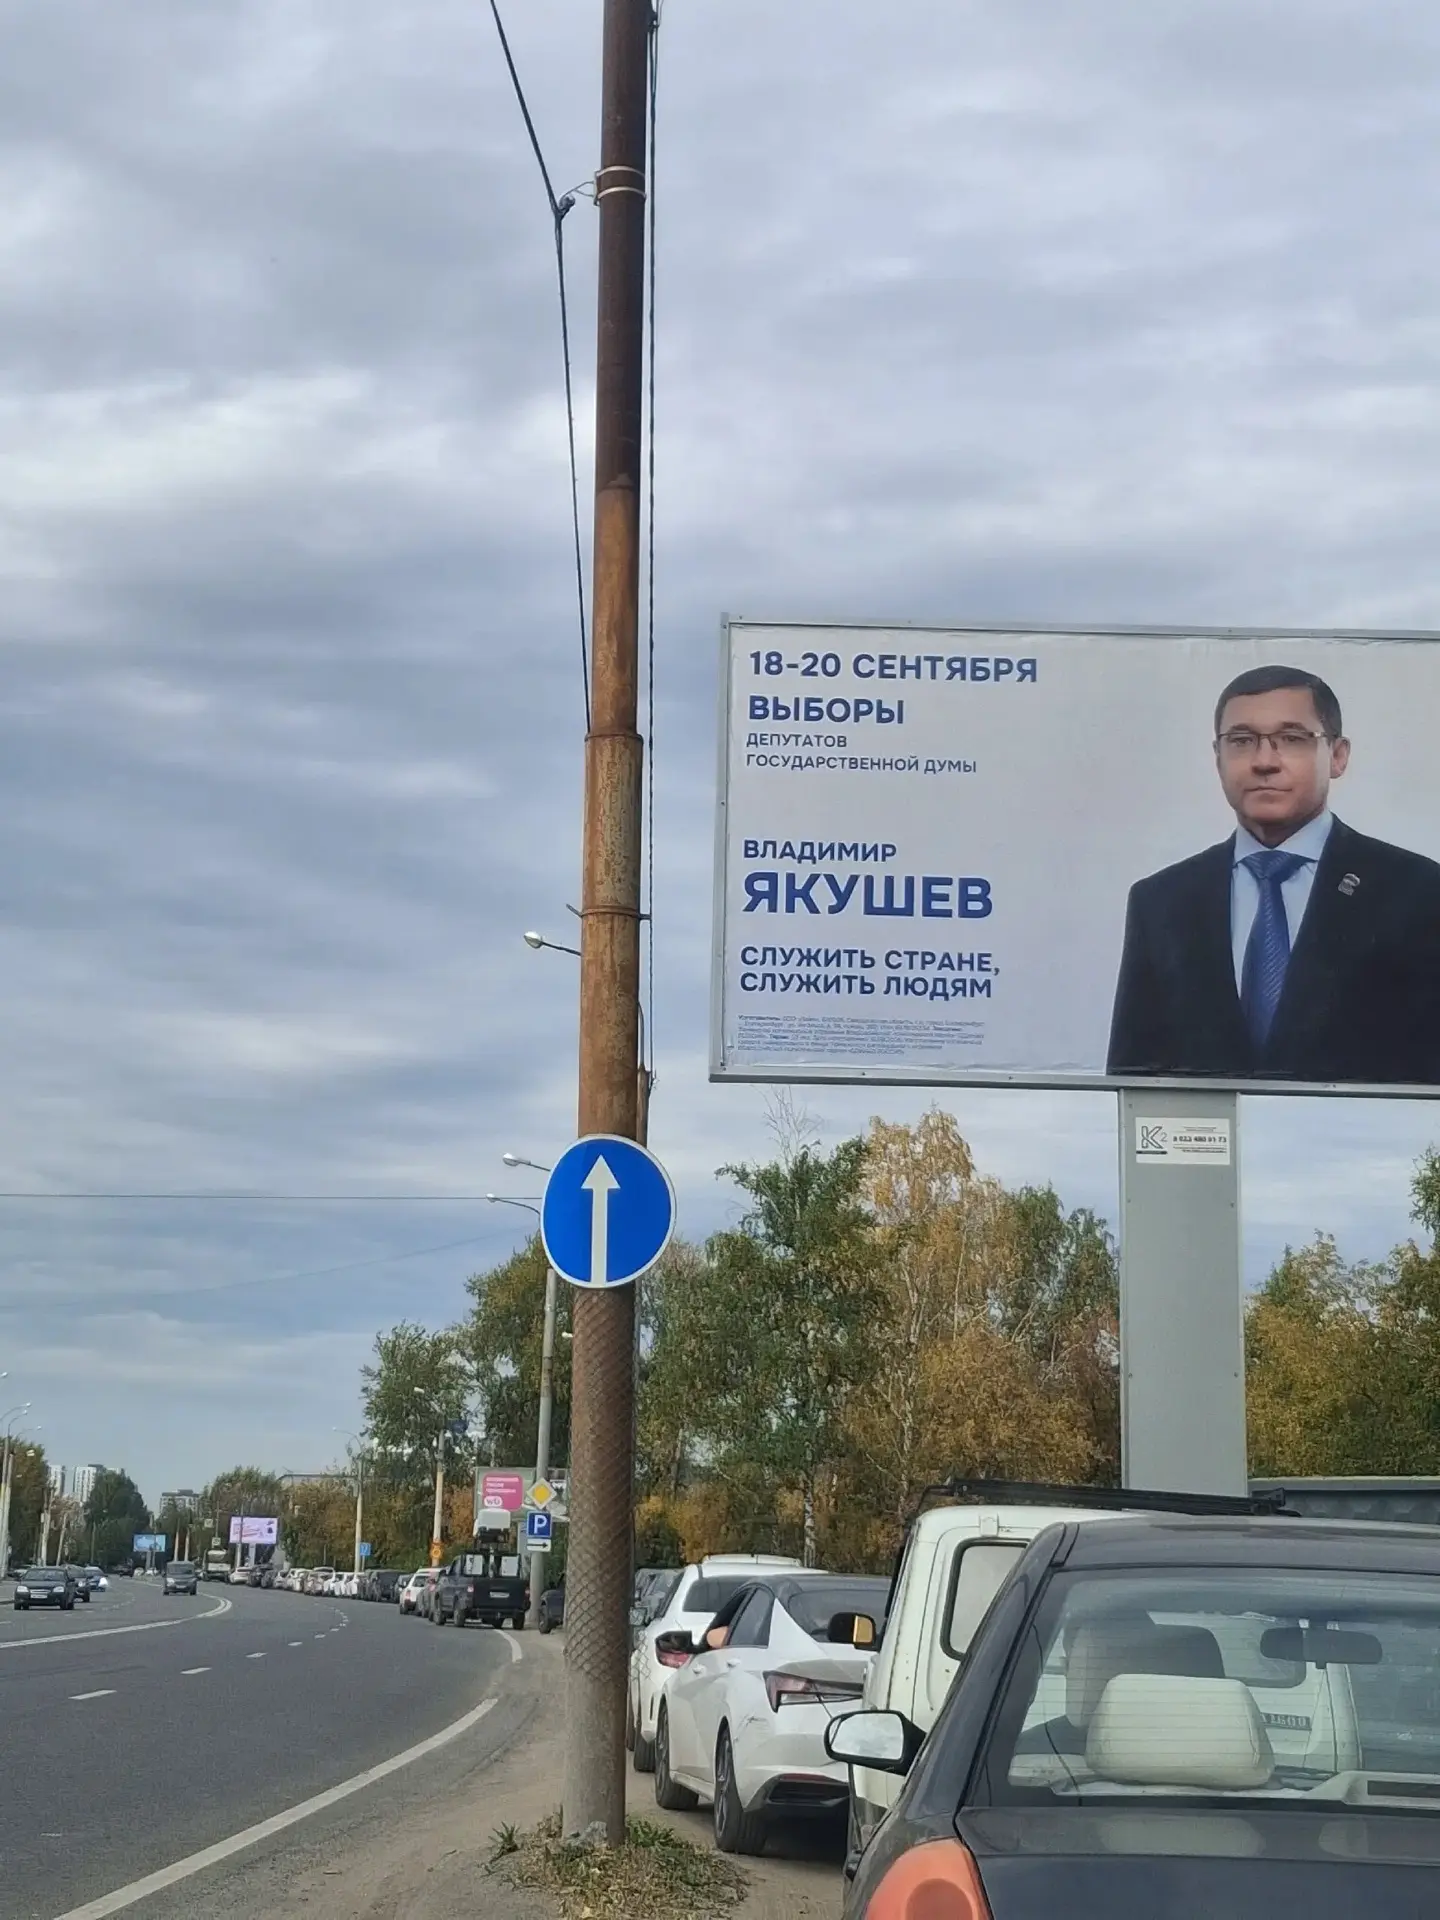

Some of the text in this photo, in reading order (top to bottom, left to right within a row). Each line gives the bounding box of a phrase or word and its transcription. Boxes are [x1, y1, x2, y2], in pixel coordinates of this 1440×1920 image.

[750, 650, 1037, 682] 18-20 СЕНТЯБРЯ
[749, 695, 904, 724] ВЫБОРЫ
[746, 733, 847, 748] ДЕПУТАТОВ
[747, 754, 977, 774] ГОСУДАРСТВЕННОЙ ДУМЫ
[743, 840, 897, 864] ВЛАДИМИР
[742, 871, 993, 918] ЯКУШЕВ
[740, 946, 1000, 976] СЛУЖИТЬ СТРАНЕ,
[740, 972, 991, 1001] СЛУЖИТЬ ЛЮДЯМ
[533, 1514, 548, 1534] P
